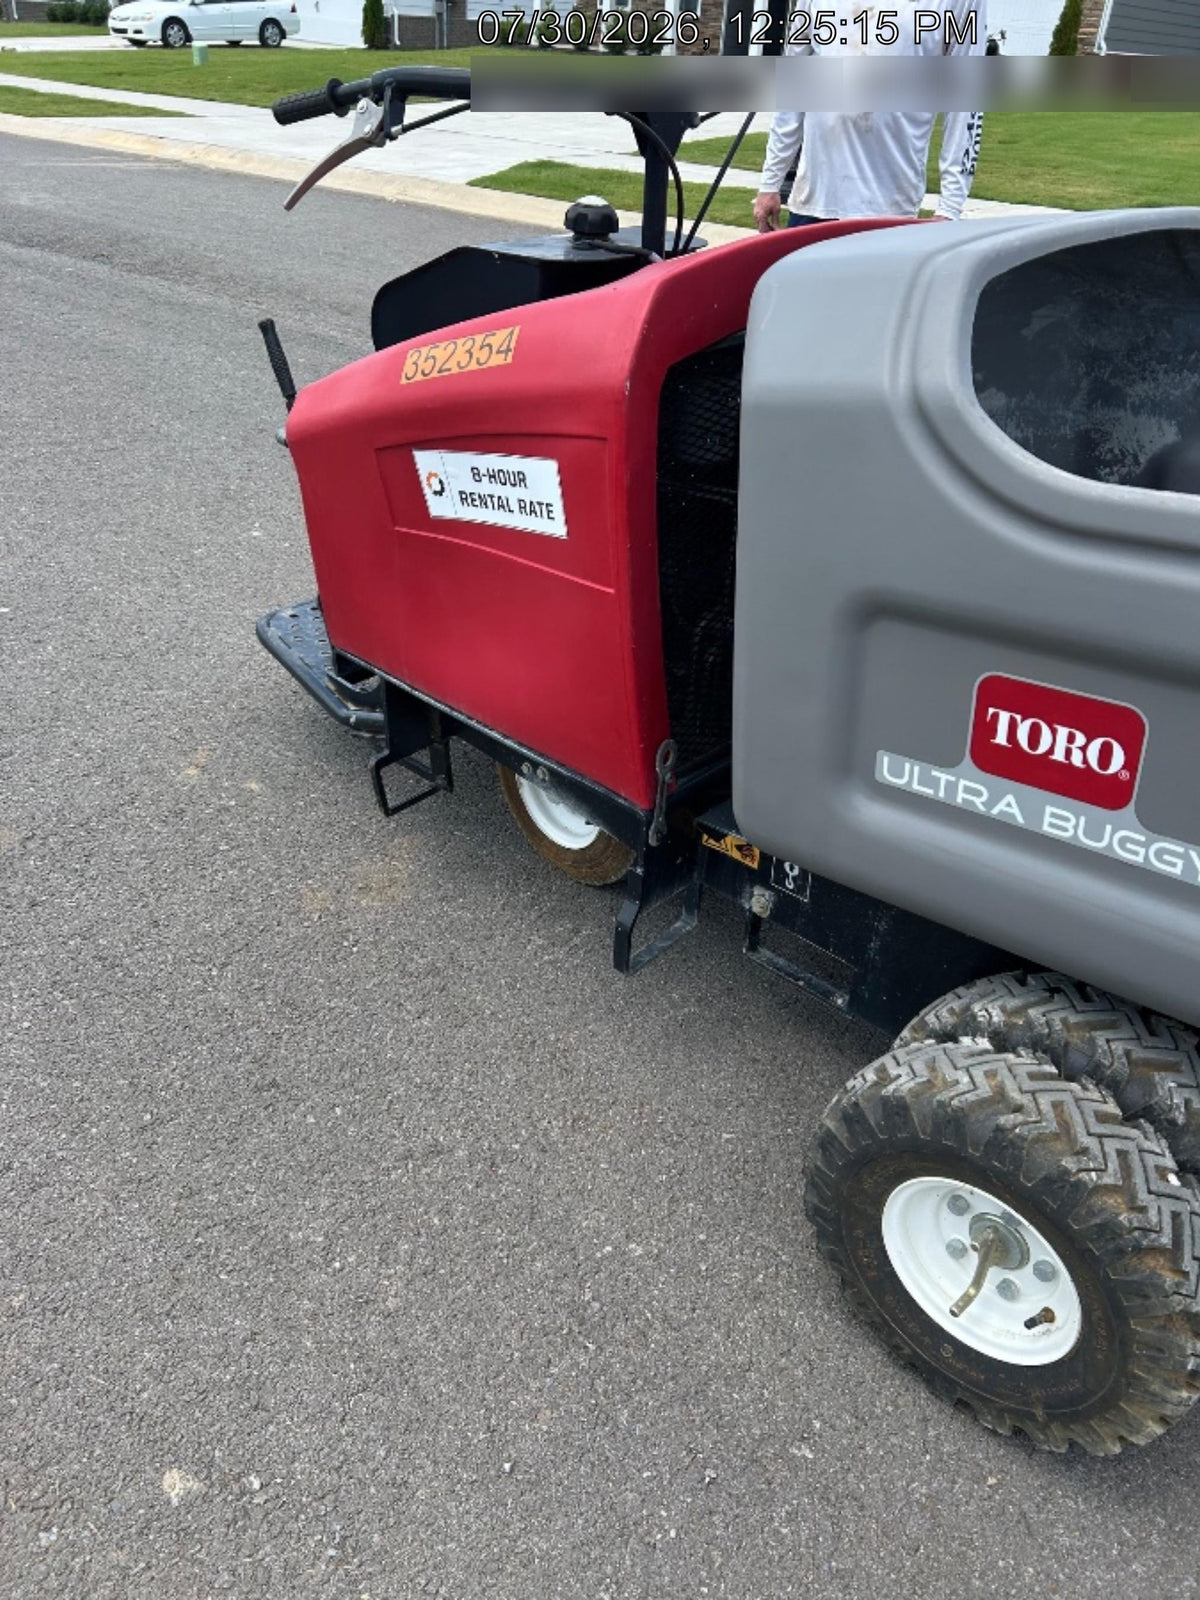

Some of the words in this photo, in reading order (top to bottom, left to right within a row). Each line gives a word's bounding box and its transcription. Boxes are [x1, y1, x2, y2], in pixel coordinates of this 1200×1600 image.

[404, 326, 517, 381] 352354
[470, 466, 529, 489] 8-HOUR
[458, 490, 515, 514] RENTAL
[518, 497, 556, 521] RATE
[882, 755, 1025, 824] ULTRA
